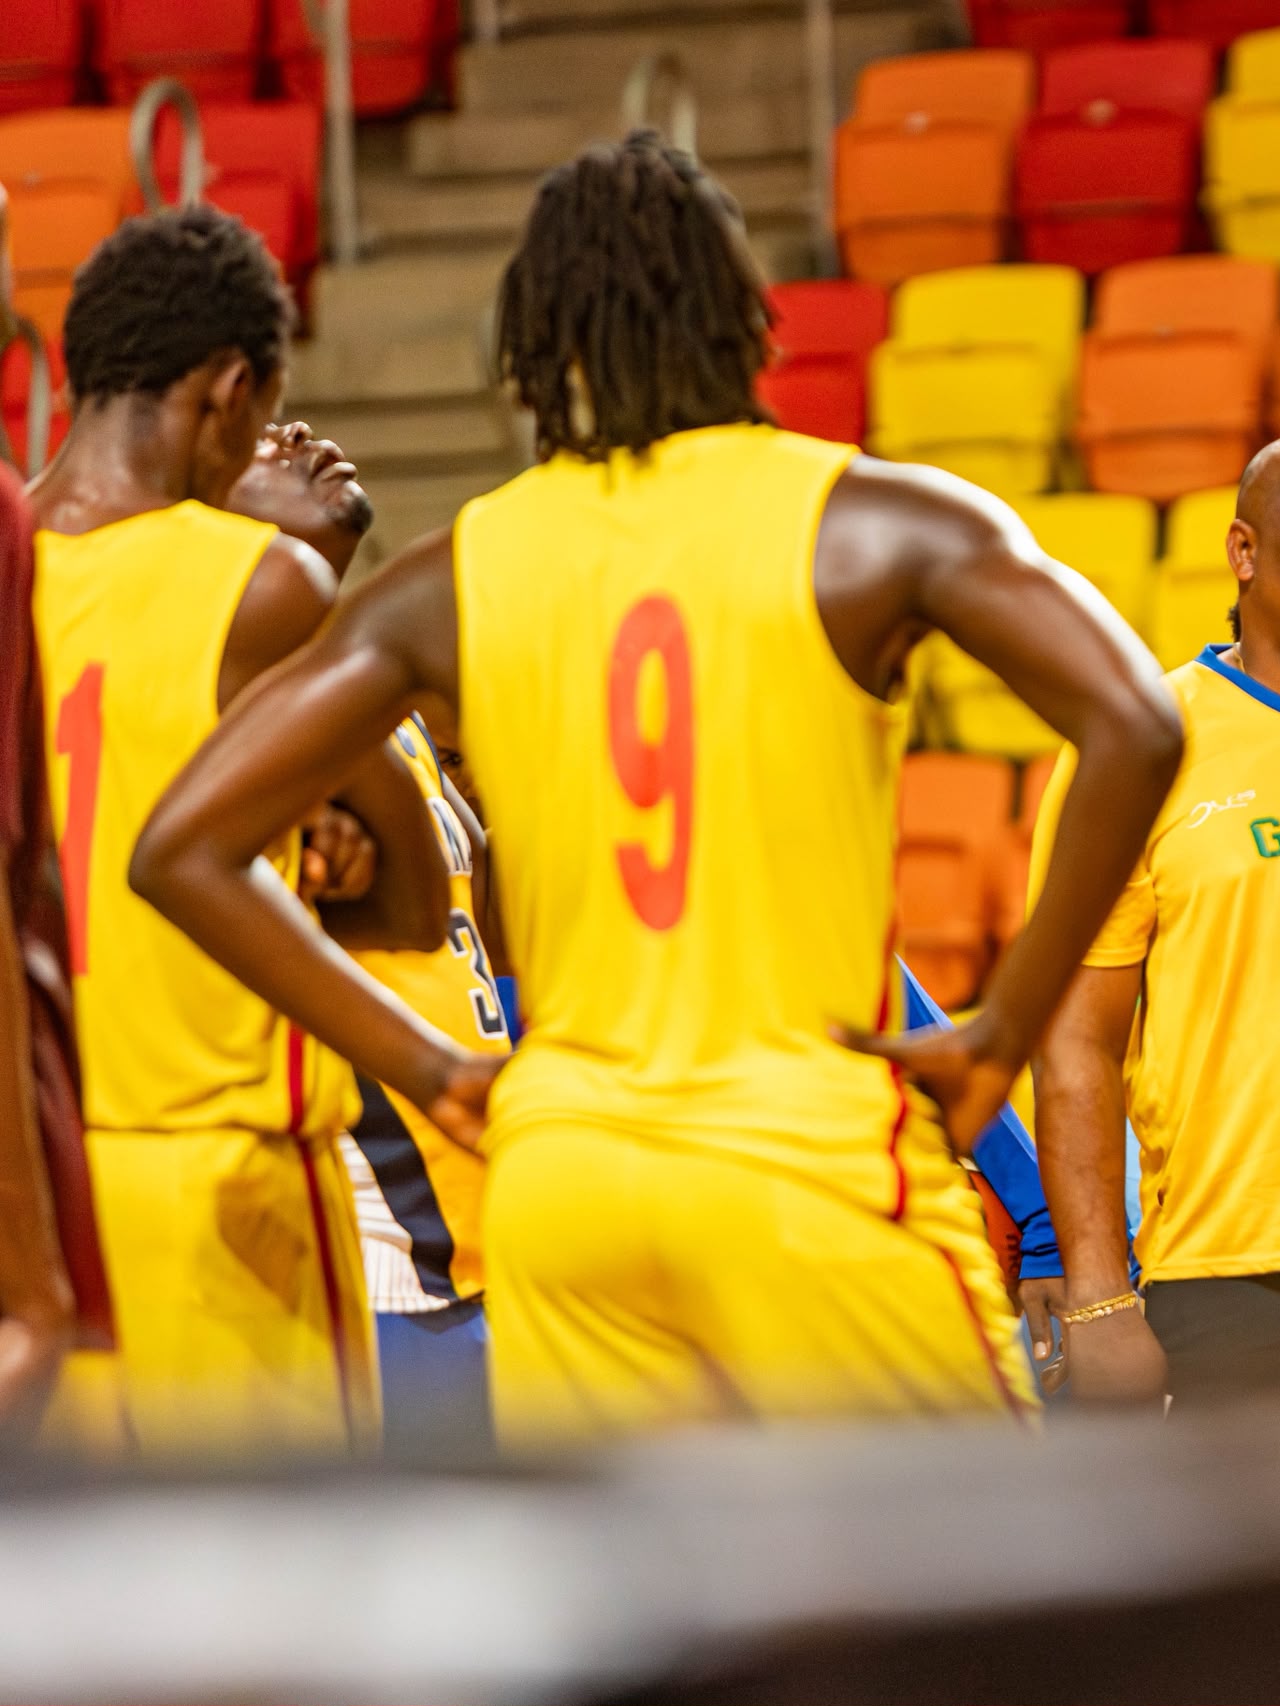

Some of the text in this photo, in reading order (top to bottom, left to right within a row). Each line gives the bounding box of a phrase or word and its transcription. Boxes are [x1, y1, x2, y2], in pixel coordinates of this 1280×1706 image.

[56, 659, 105, 975] 1
[608, 594, 693, 930] 9
[448, 907, 507, 1039] 3
